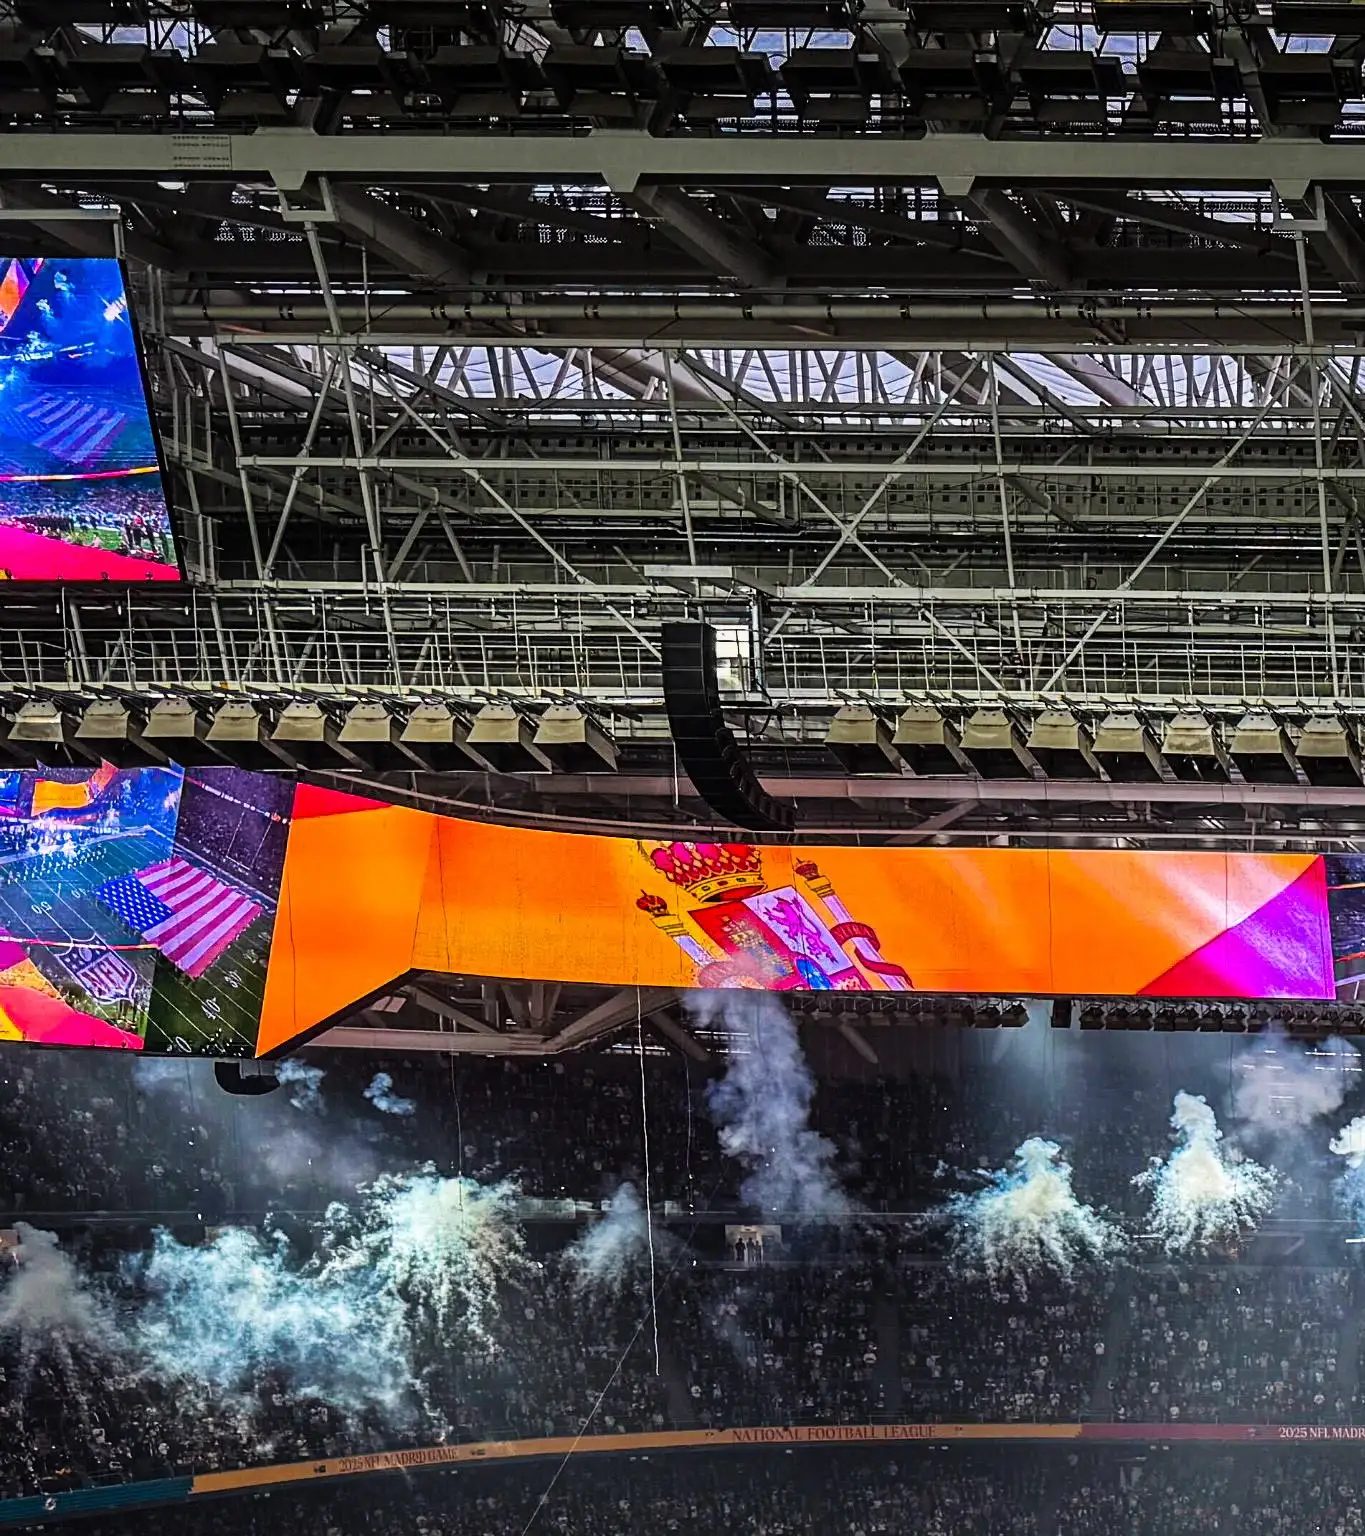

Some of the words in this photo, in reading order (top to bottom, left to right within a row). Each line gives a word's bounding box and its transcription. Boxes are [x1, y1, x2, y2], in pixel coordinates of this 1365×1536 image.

[733, 1428, 800, 1442] NATIONAL
[808, 1426, 880, 1441] FOOTBALL
[884, 1425, 937, 1439] LEAGUE
[1279, 1427, 1307, 1439] 2025
[1309, 1427, 1330, 1439] NFL
